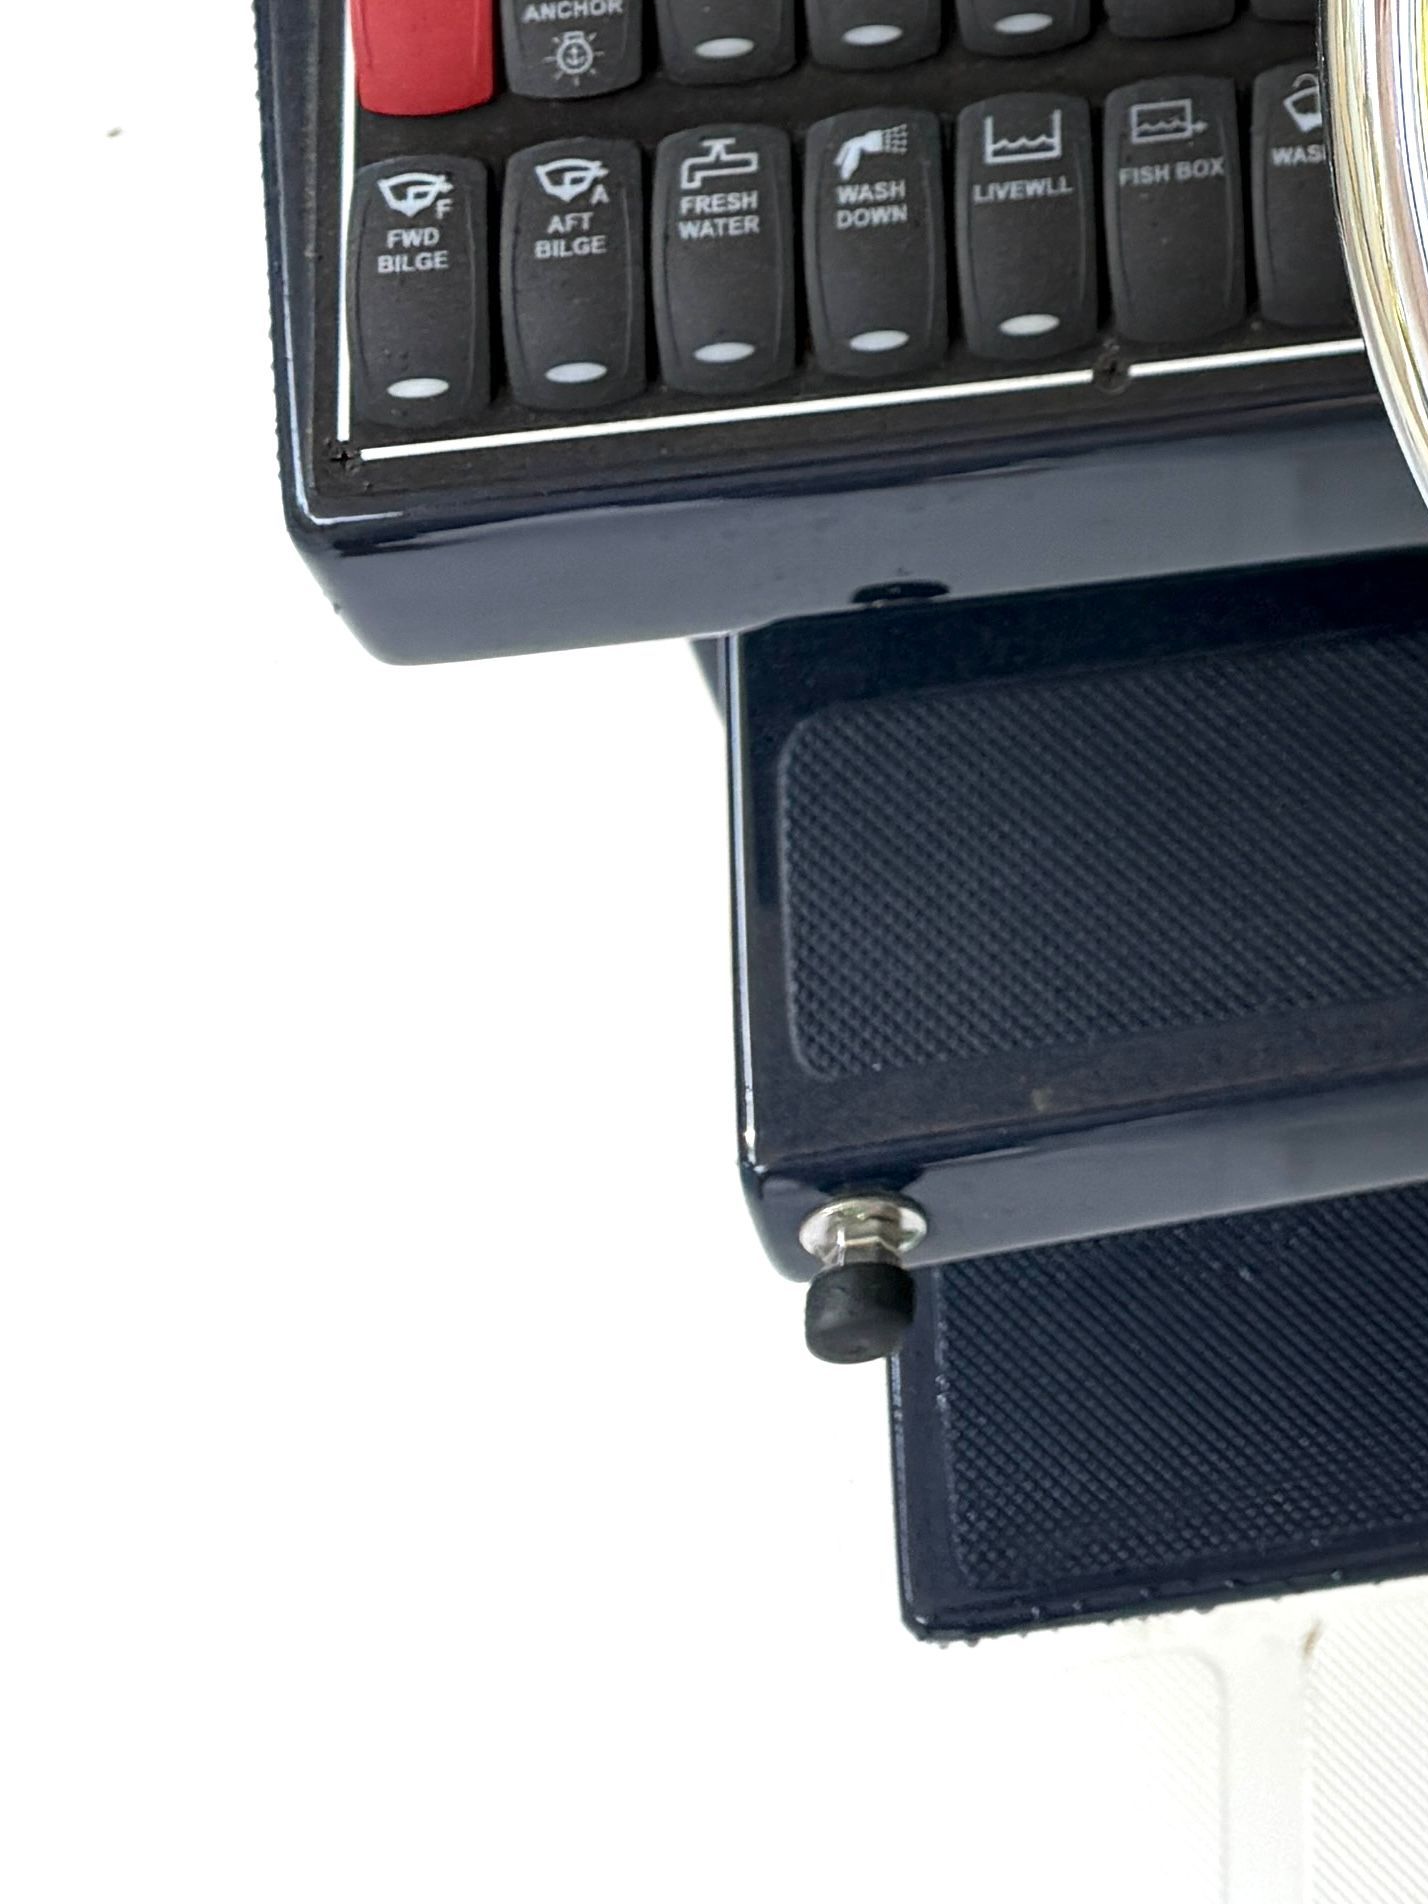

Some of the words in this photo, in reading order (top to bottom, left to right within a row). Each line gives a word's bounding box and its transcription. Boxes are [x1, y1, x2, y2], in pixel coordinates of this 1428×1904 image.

[1117, 163, 1172, 188] FISH
[1175, 155, 1226, 182] BOX
[834, 178, 907, 205] WASH
[972, 174, 1075, 204] LIVEWLL
[679, 190, 760, 217] FRESH
[835, 203, 909, 231] DOWN
[546, 211, 596, 235] AFT
[677, 214, 761, 241] WATER
[386, 227, 441, 251] FWD
[533, 234, 608, 261] BILGE
[376, 249, 450, 275] BILGE
